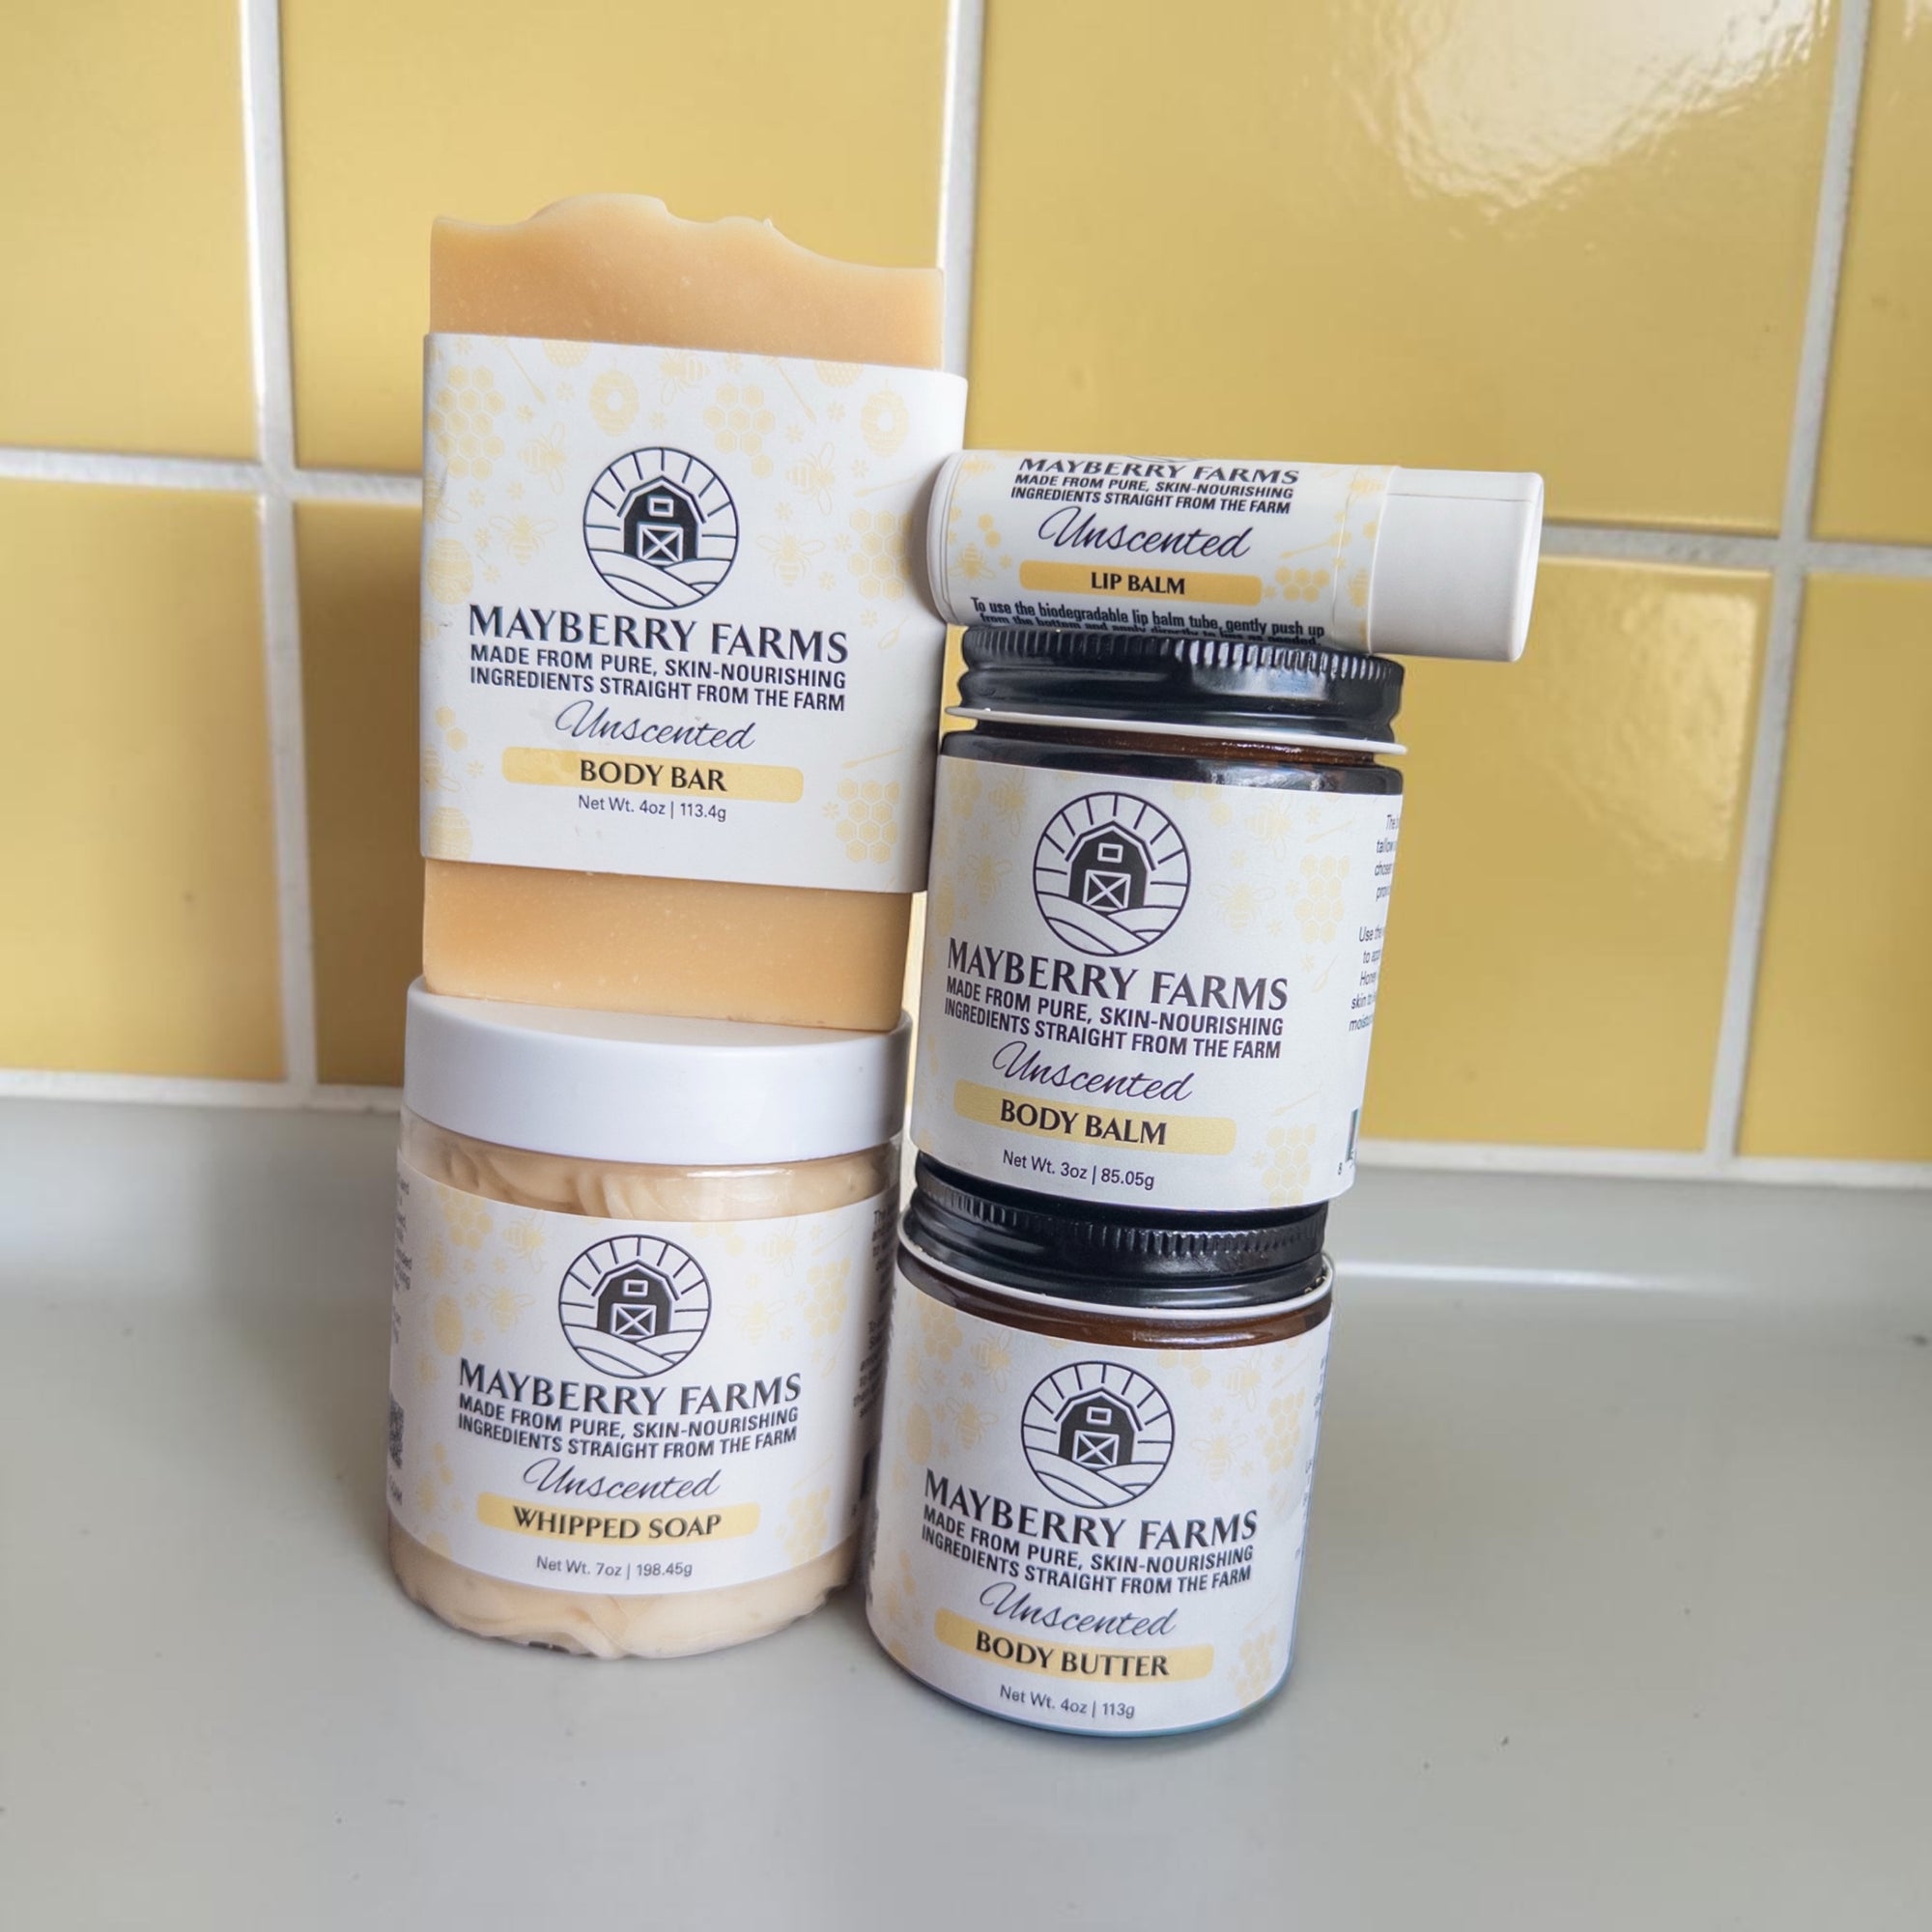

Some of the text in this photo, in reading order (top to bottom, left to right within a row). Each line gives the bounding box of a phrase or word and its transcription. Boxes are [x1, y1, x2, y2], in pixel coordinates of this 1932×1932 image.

[1015, 474, 1293, 498] MADE FROM PURE, SKIN-NOURISHING
[1018, 458, 1299, 484] MAYBERRY FARMS
[1010, 487, 1290, 514] INGREDIENTS STRAIGHT FROM THE FARM
[1037, 505, 1254, 558] Unscented
[1091, 573, 1185, 594] LIP BALM
[469, 604, 848, 664] MAYBERRY FARMS
[971, 597, 986, 611] To
[989, 603, 1011, 613] use
[1014, 601, 1036, 616] the
[1038, 603, 1128, 623] biodegradable
[1132, 610, 1149, 626] lip
[1152, 611, 1184, 627] balm
[1226, 618, 1267, 635] gently
[1272, 621, 1303, 637] push
[1309, 626, 1324, 638] up
[470, 643, 846, 689] MADE FROM PURE, SKIN-NOURISHING
[470, 667, 845, 712] INGREDIENTS STRAIGHT FROM THE FARM
[554, 699, 755, 750] Unscented
[580, 759, 727, 792] BODY BAR
[579, 795, 604, 811] Net
[609, 797, 635, 813] Wt.
[639, 800, 666, 816] 4oz
[681, 802, 726, 821] 113.4g
[948, 937, 1288, 1010] MAYBERRY FARMS
[944, 998, 1281, 1059] INGREDIENTS STRAIGHT FROM THE FARM
[946, 976, 1284, 1037] MADE FROM PURE, SKIN-NOURISHING
[992, 1040, 1193, 1102] Unscented
[1000, 1098, 1167, 1146] BODY BALM
[1003, 1150, 1027, 1169] Net
[1032, 1155, 1056, 1176] Wt.
[1061, 1161, 1088, 1179] 3oz
[1100, 1167, 1154, 1190] 85.05g
[460, 1358, 802, 1416] MAYBERRY FARMS
[458, 1413, 797, 1460] INGREDIENTS STRAIGHT FROM THE FARM
[459, 1393, 798, 1438] MADE FROM PURE, SKIN-NOURISHING
[523, 1458, 723, 1500] Unscented
[512, 1506, 723, 1539] WHIPPED SOAP
[924, 1468, 1258, 1549] MAYBERRY FARMS
[922, 1527, 1251, 1594] INGREDIENTS STRAIGHT FROM THE FARM
[923, 1505, 1253, 1574] MADE FROM PURE, SKIN-NOURISHING
[536, 1556, 561, 1573] Net
[565, 1559, 591, 1576] Wt.
[596, 1561, 621, 1577] 7oz
[636, 1561, 693, 1578] 198.45g
[979, 1581, 1179, 1636] Unscented
[976, 1630, 1170, 1677] BODY BUTTER
[1000, 1685, 1025, 1702] Net
[1030, 1691, 1056, 1710] Wt.
[1060, 1698, 1088, 1716] 4oz
[1101, 1702, 1135, 1719] 113g
